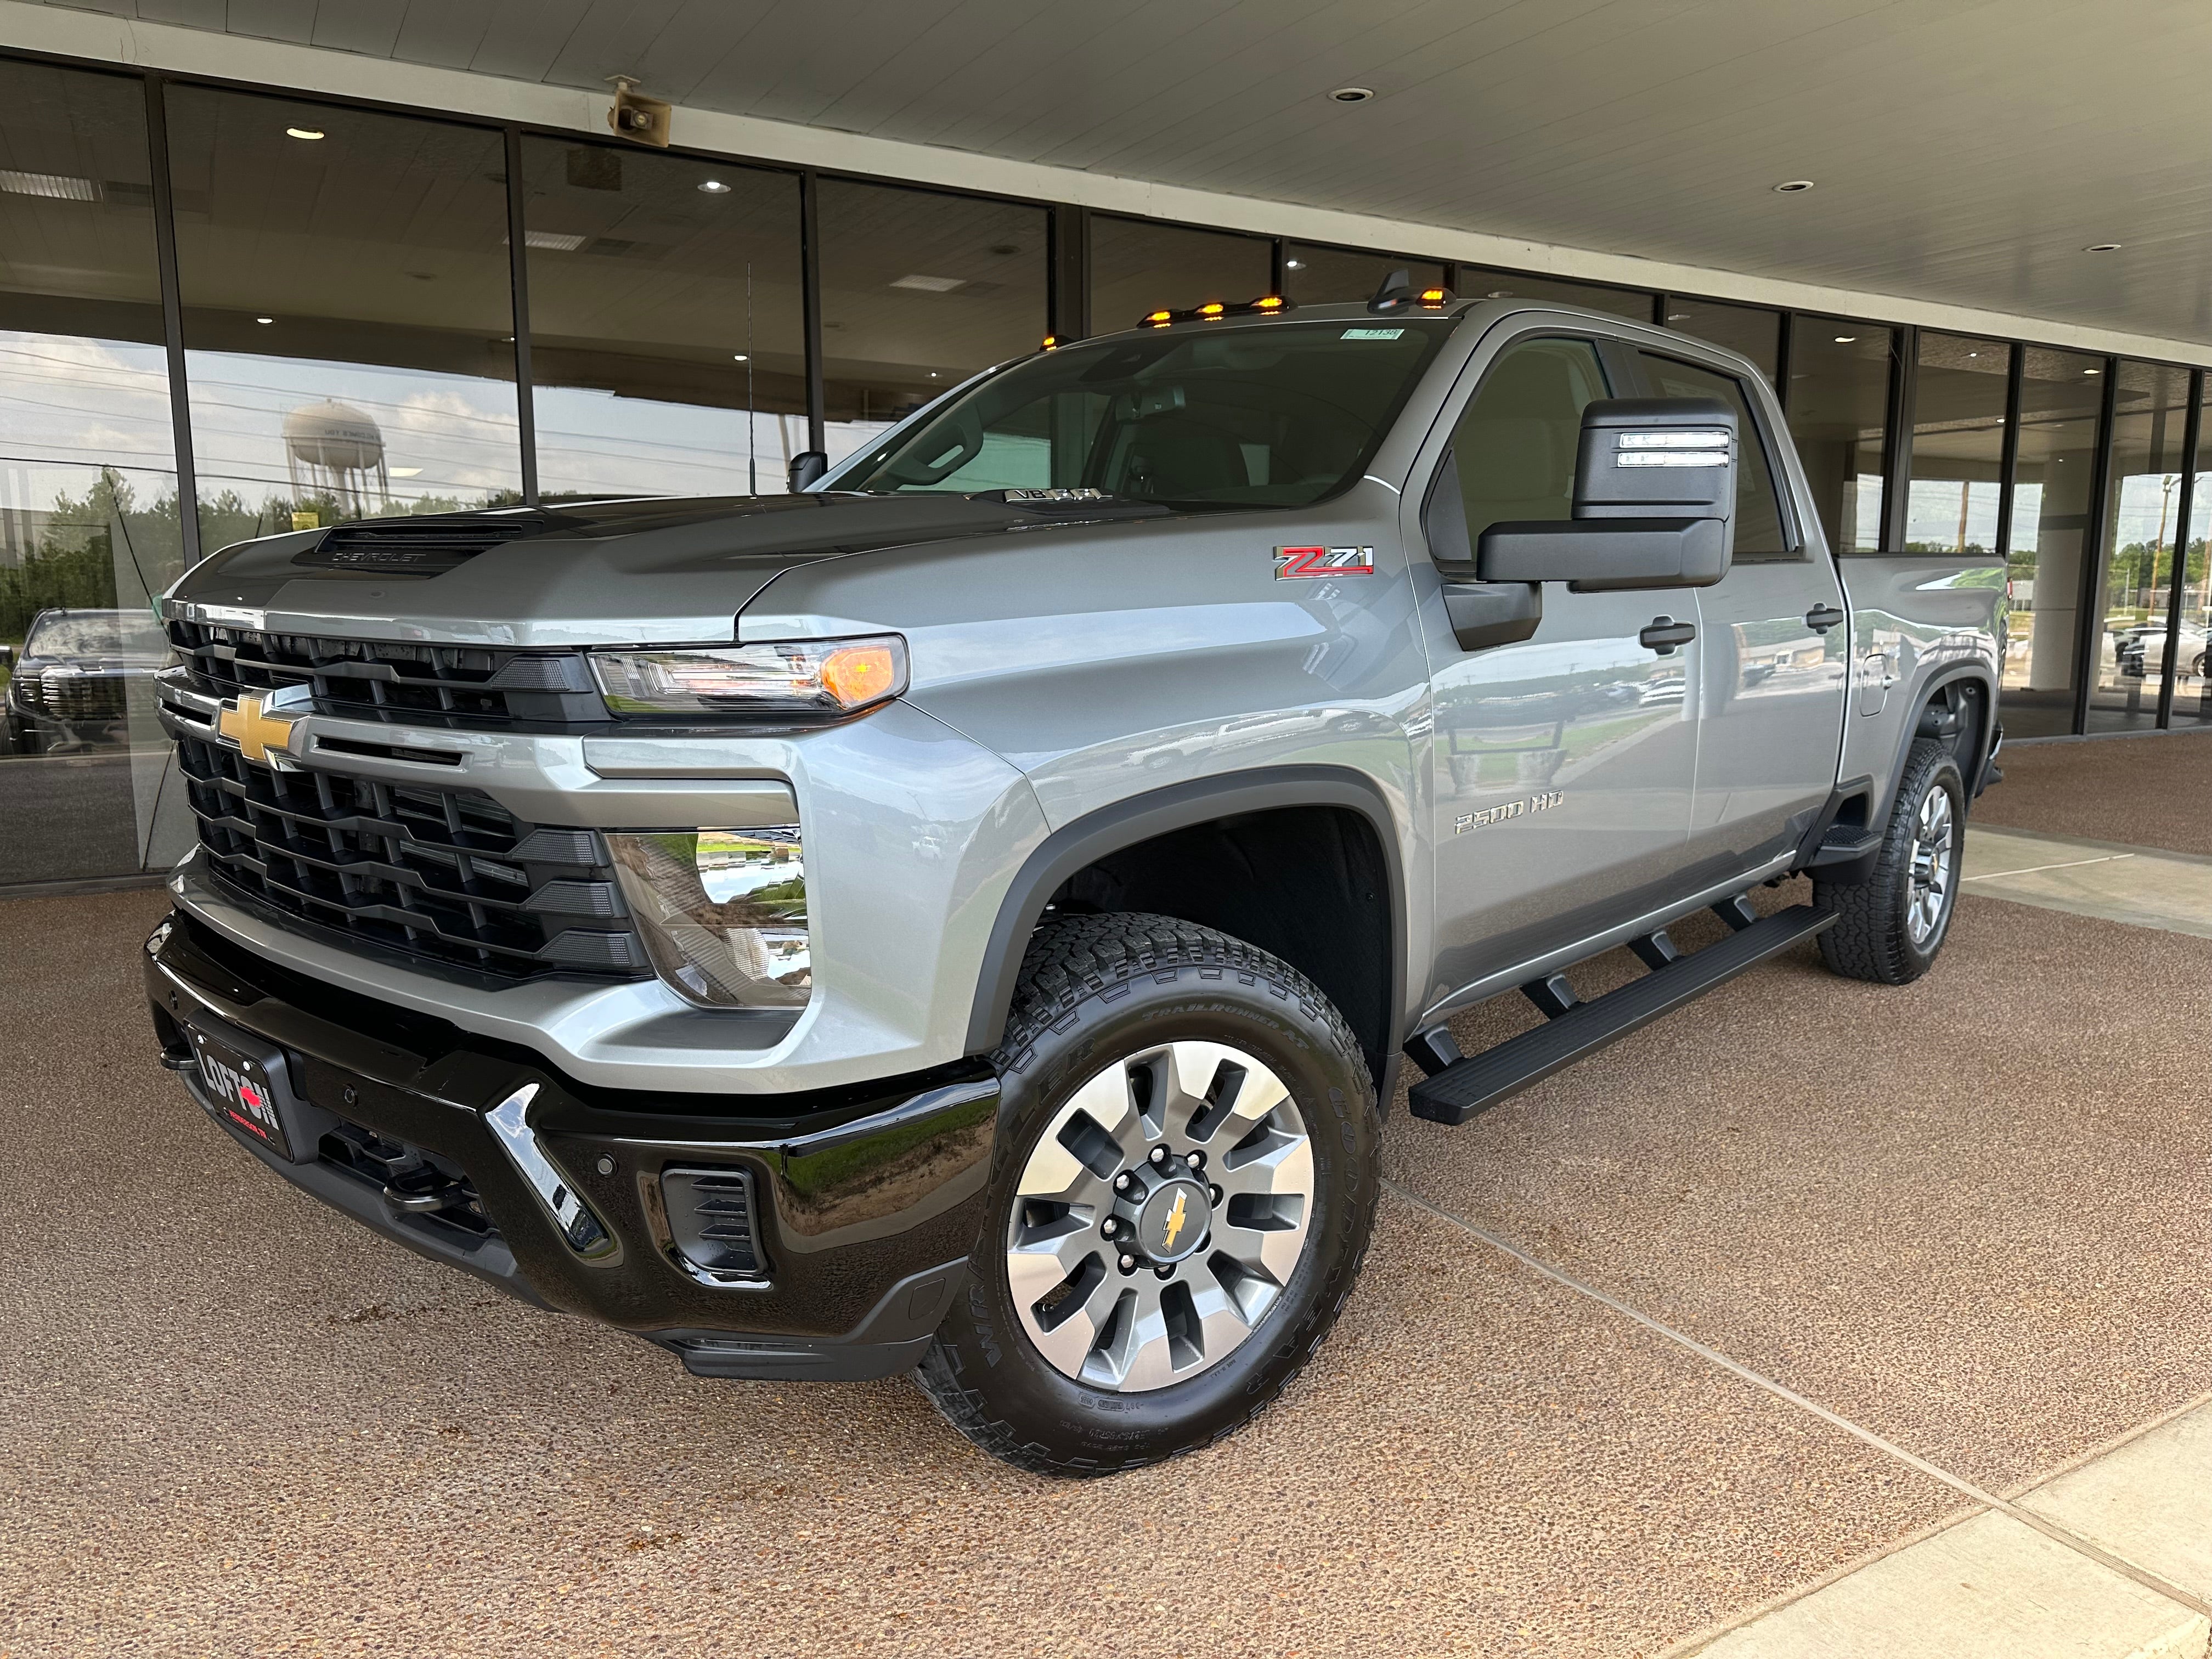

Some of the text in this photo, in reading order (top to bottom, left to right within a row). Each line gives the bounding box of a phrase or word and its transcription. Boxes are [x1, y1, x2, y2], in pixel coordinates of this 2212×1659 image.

[332, 553, 426, 562] CHEVROLET
[1273, 545, 1373, 580] Z71
[1455, 790, 1564, 834] 2500 HD
[196, 1047, 279, 1131] LOFTON
[1245, 1087, 1359, 1395] GOODYEAR
